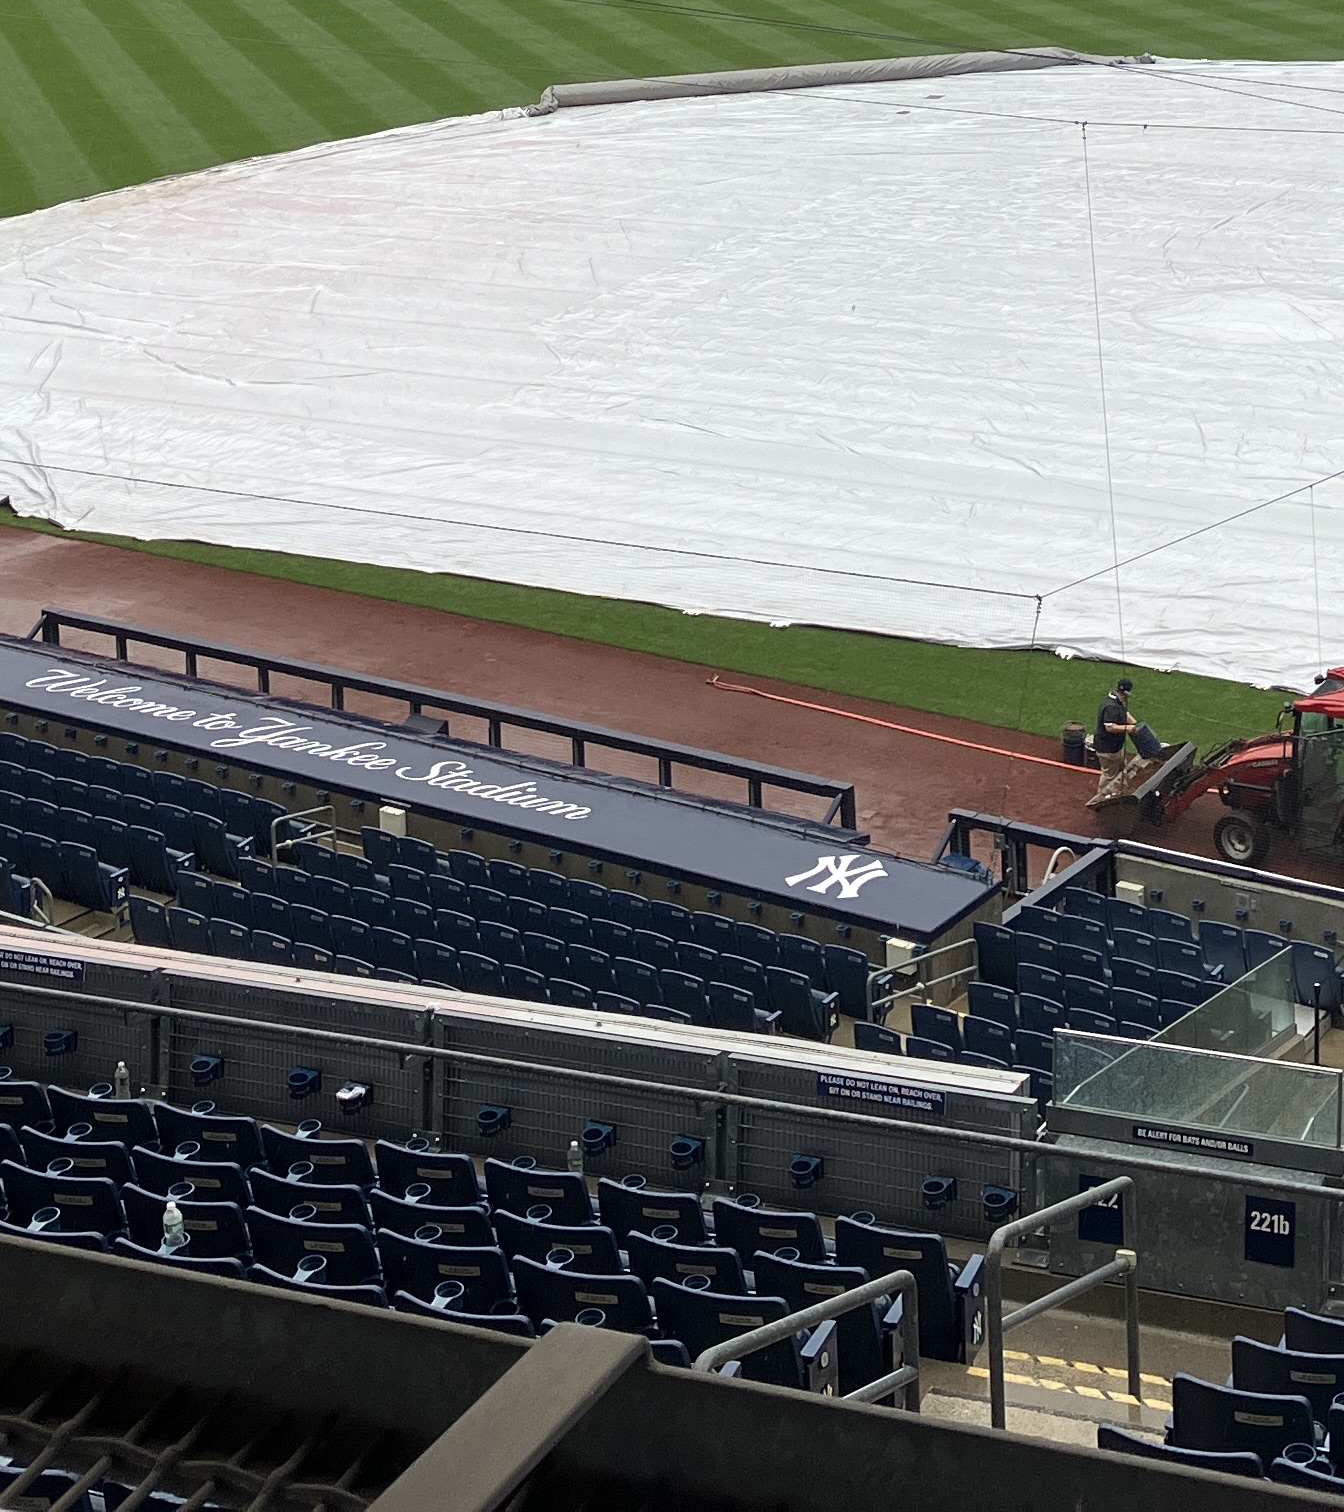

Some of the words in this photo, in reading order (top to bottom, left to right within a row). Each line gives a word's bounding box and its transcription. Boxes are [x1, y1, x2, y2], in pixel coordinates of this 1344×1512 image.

[25, 668, 197, 724] Welcome
[191, 711, 243, 731] to
[211, 716, 397, 772] Yankee
[395, 760, 592, 822] Stadium
[784, 854, 889, 899] NY
[1138, 1128, 1146, 1137] BE
[1148, 1130, 1167, 1141] ALERT
[1169, 1133, 1181, 1143] FOR
[1183, 1135, 1199, 1146] BATS
[1201, 1138, 1226, 1150] AND/OR
[1228, 1141, 1249, 1153] BALLS
[1250, 1211, 1290, 1235] 221b
